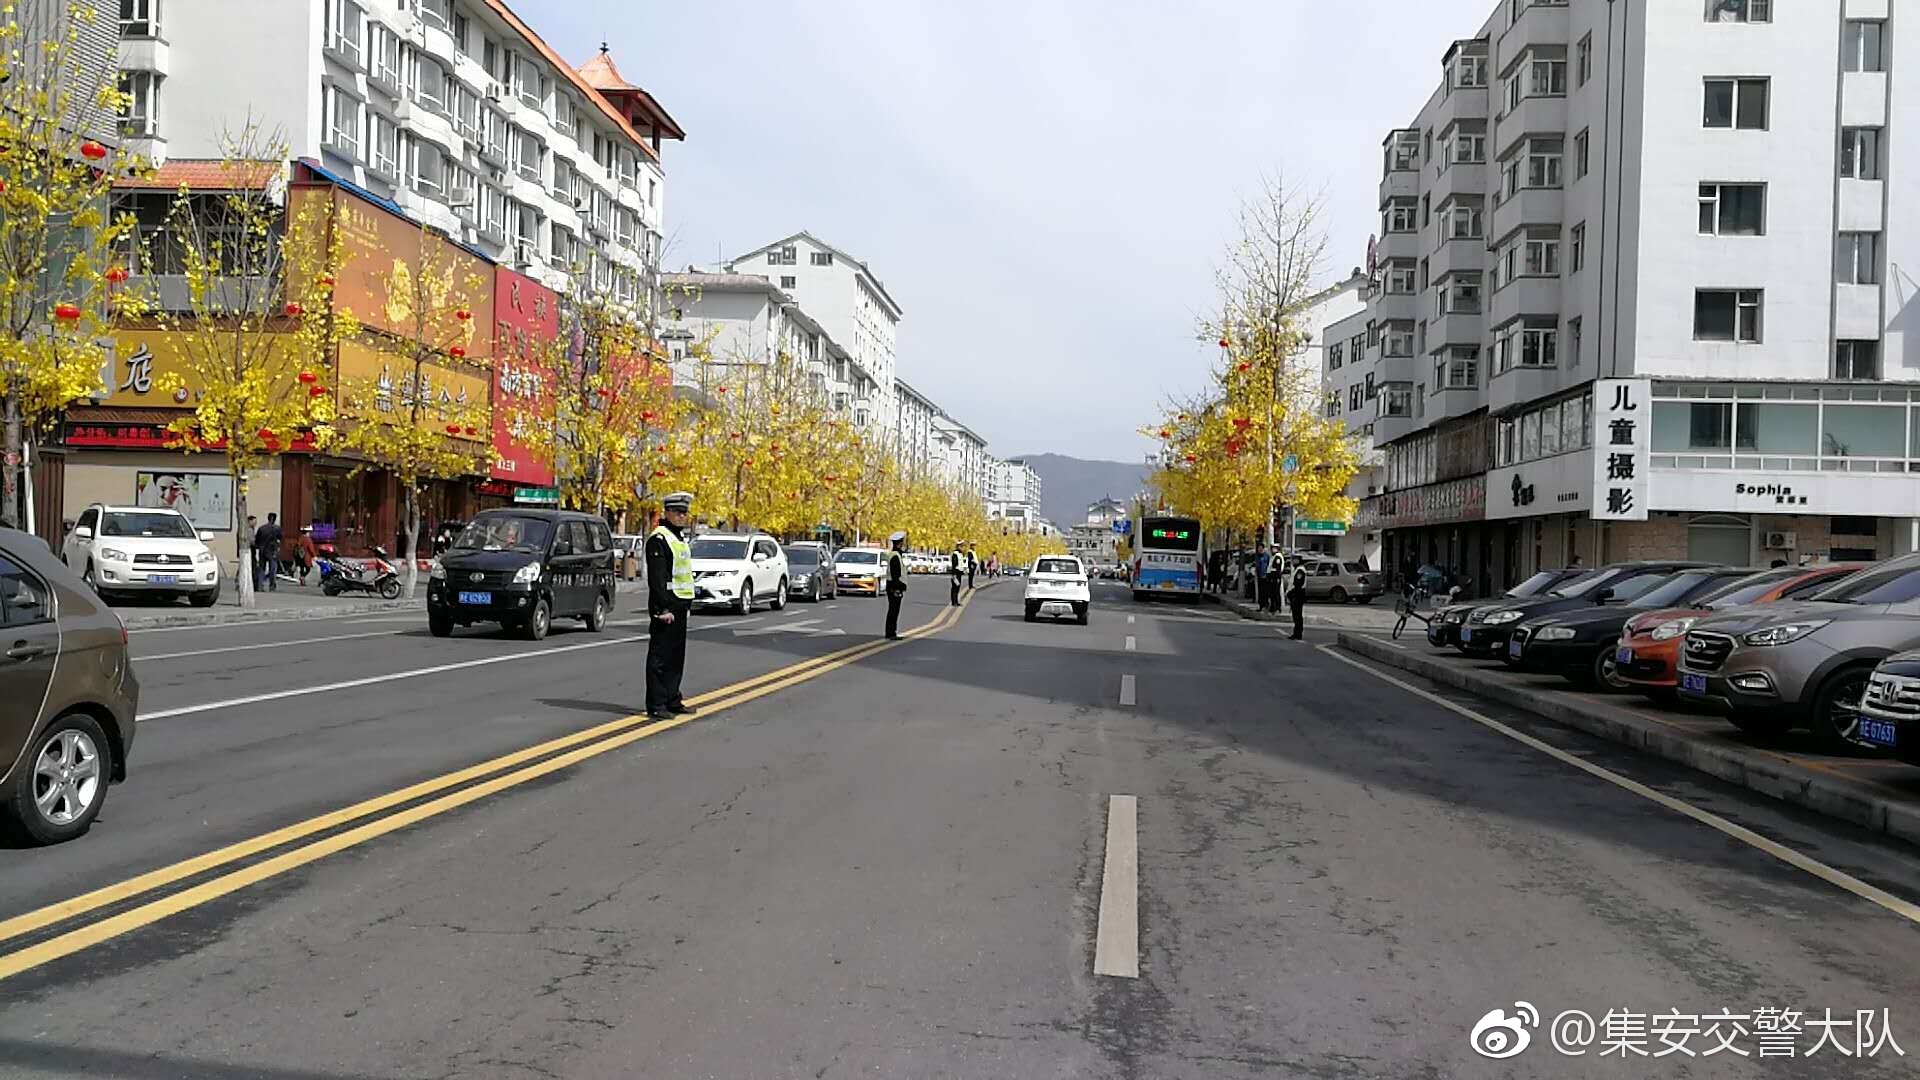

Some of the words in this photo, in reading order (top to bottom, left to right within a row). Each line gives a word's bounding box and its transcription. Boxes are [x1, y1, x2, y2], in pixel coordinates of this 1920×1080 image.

[120, 342, 153, 393] 店
[1606, 384, 1637, 515] 儿童摄影
[1735, 483, 1792, 497] Sophia
